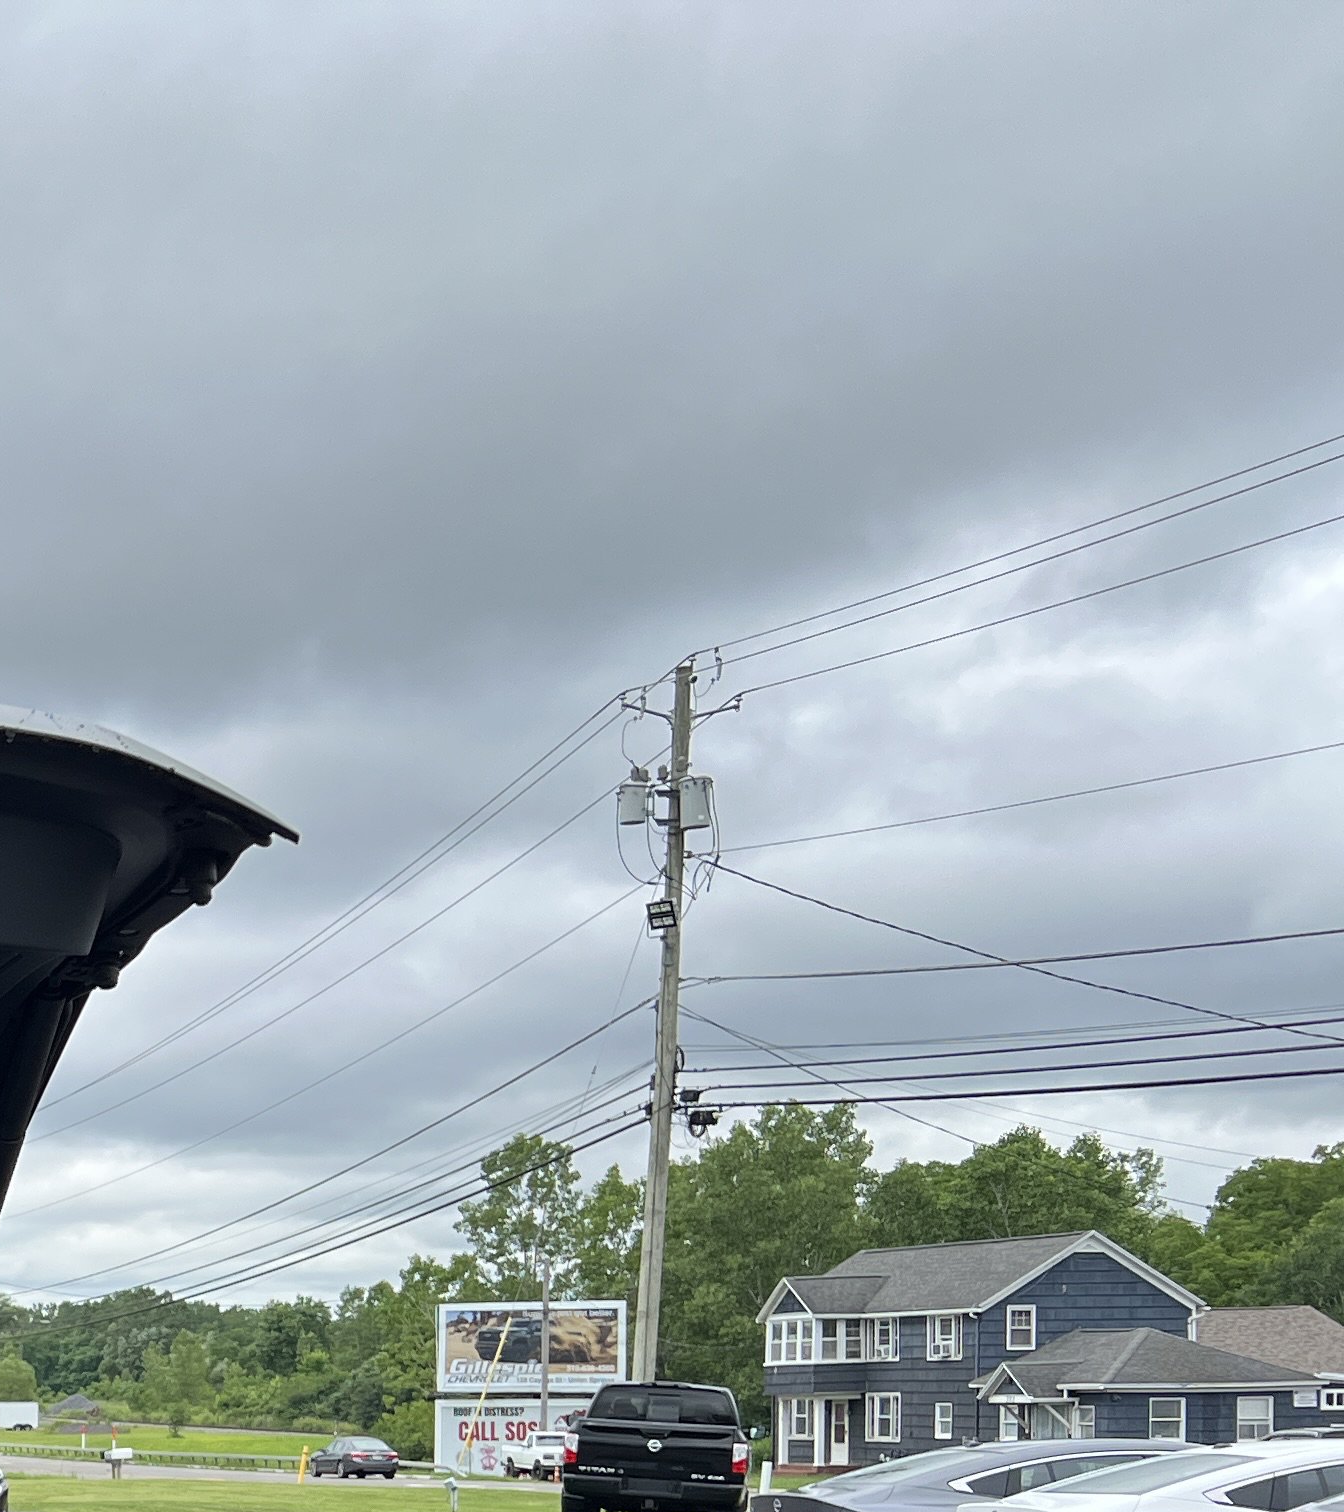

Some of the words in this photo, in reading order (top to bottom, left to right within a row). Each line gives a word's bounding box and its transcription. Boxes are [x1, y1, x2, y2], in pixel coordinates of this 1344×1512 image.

[454, 1407, 472, 1416] ROOF
[459, 1421, 499, 1441] CALL
[578, 1465, 616, 1473] TITAN
